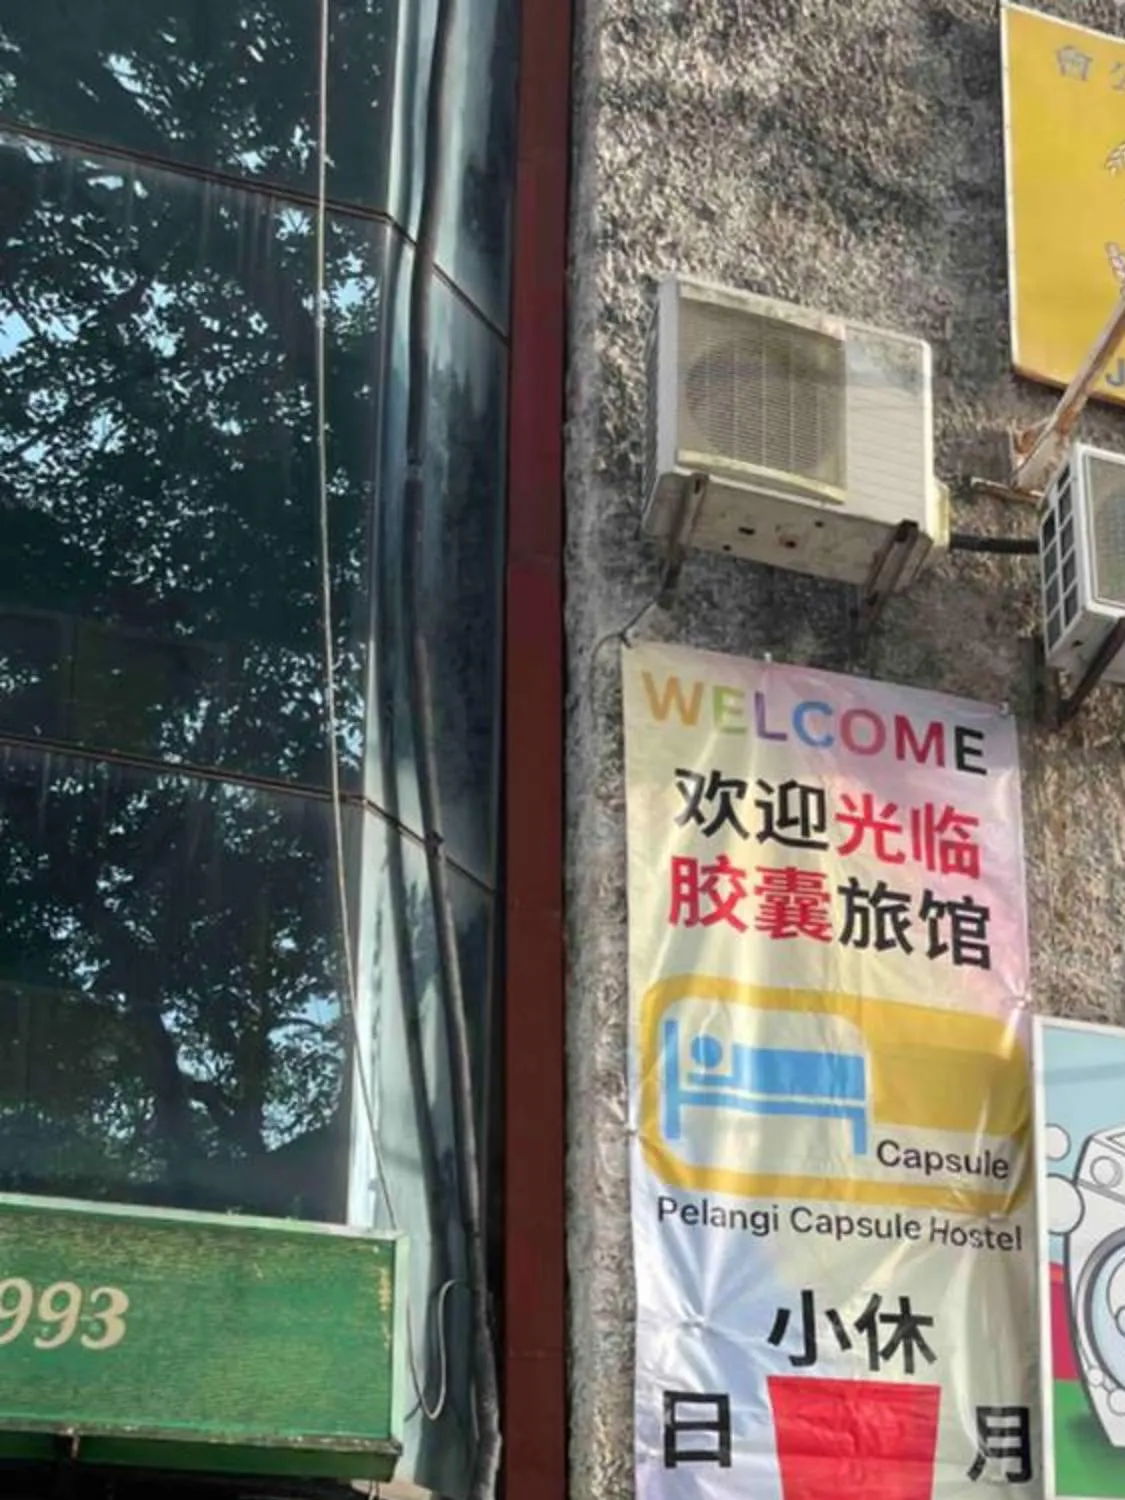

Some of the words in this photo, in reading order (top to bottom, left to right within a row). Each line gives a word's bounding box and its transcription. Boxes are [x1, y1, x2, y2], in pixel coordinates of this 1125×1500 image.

[641, 670, 988, 776] WELCOME
[673, 766, 982, 880] 欢迎光临
[667, 854, 993, 971] 胶囊旅馆
[876, 1139, 1010, 1181] Capsule
[657, 1196, 780, 1236] Pelangi
[791, 1205, 922, 1246] Capsule
[930, 1216, 1023, 1252] Hostel
[0, 1277, 130, 1351] 993
[767, 1289, 938, 1375] 小休
